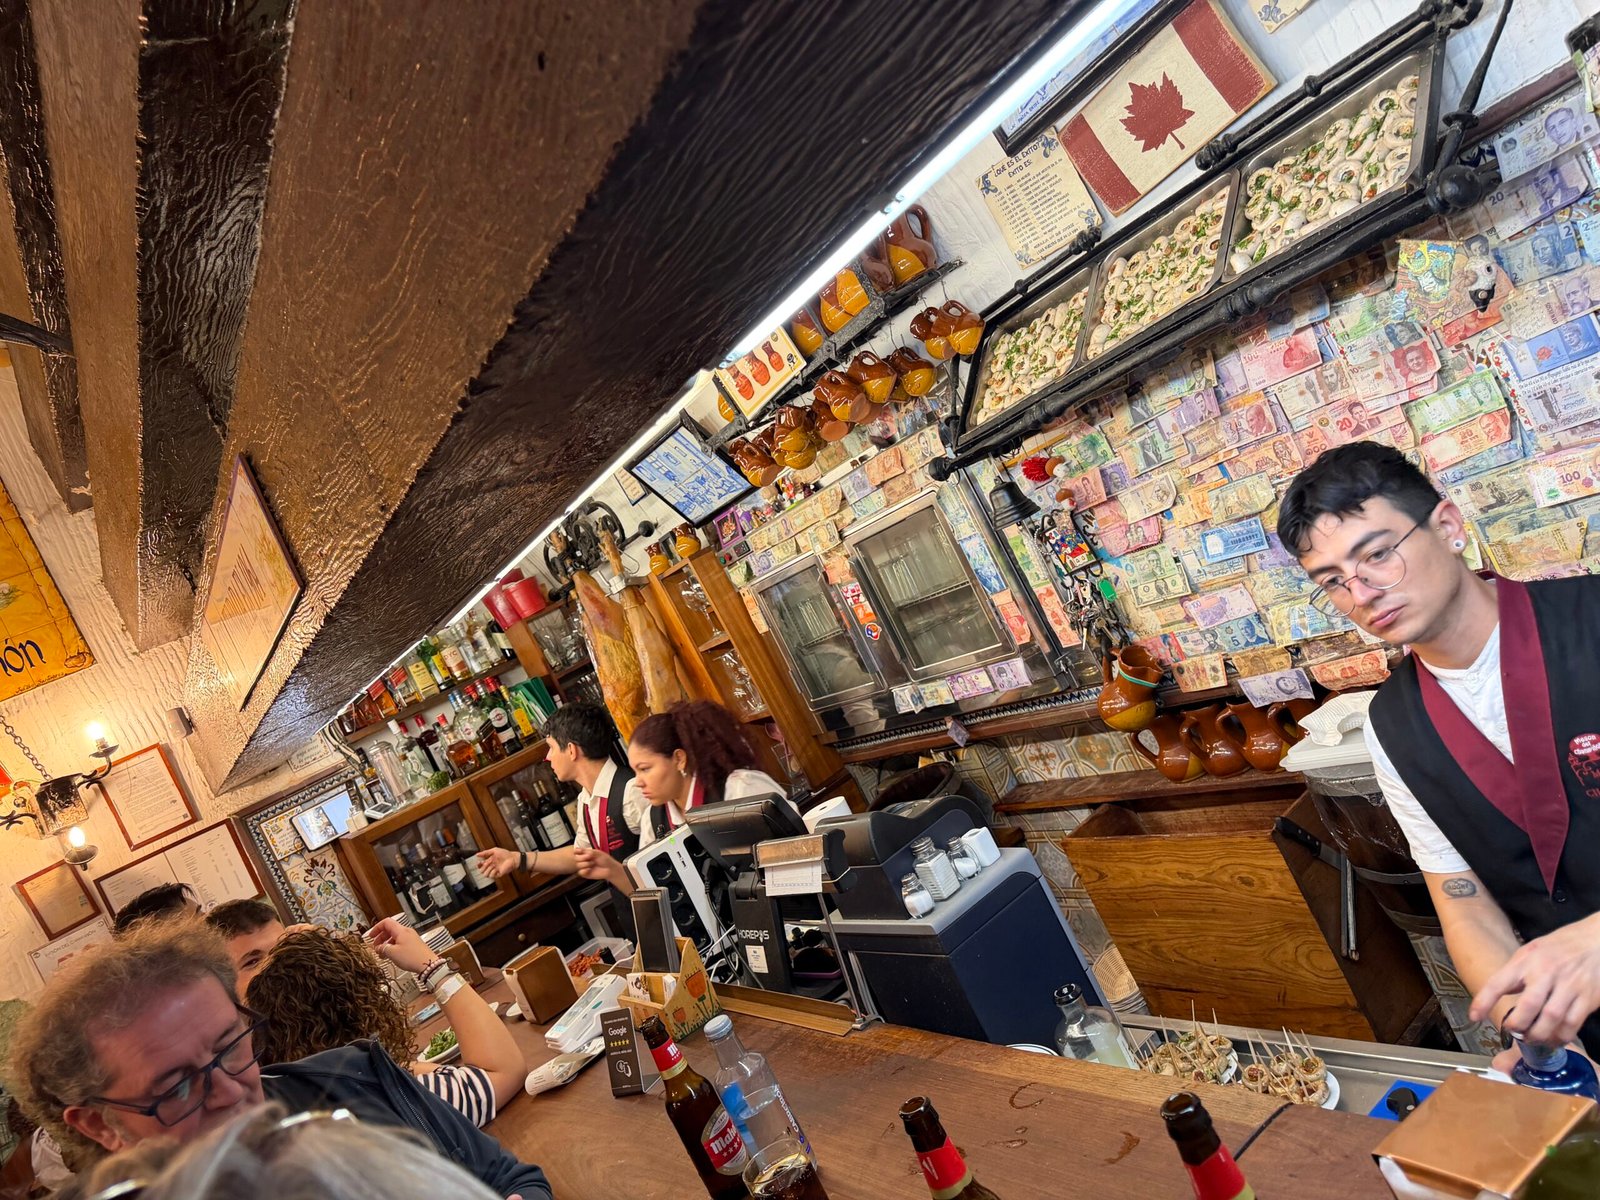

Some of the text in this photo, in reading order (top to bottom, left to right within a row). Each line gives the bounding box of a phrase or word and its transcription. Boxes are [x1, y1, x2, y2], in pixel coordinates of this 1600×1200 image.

[1005, 159, 1015, 167] ES
[1013, 154, 1021, 162] EL
[1489, 190, 1504, 204] 20
[1562, 224, 1573, 237] 2
[1334, 415, 1353, 432] 20
[1559, 469, 1581, 485] 100
[1191, 600, 1201, 609] 100
[1230, 634, 1240, 647] 5
[442, 647, 457, 659] DYC
[607, 1023, 627, 1037] Google
